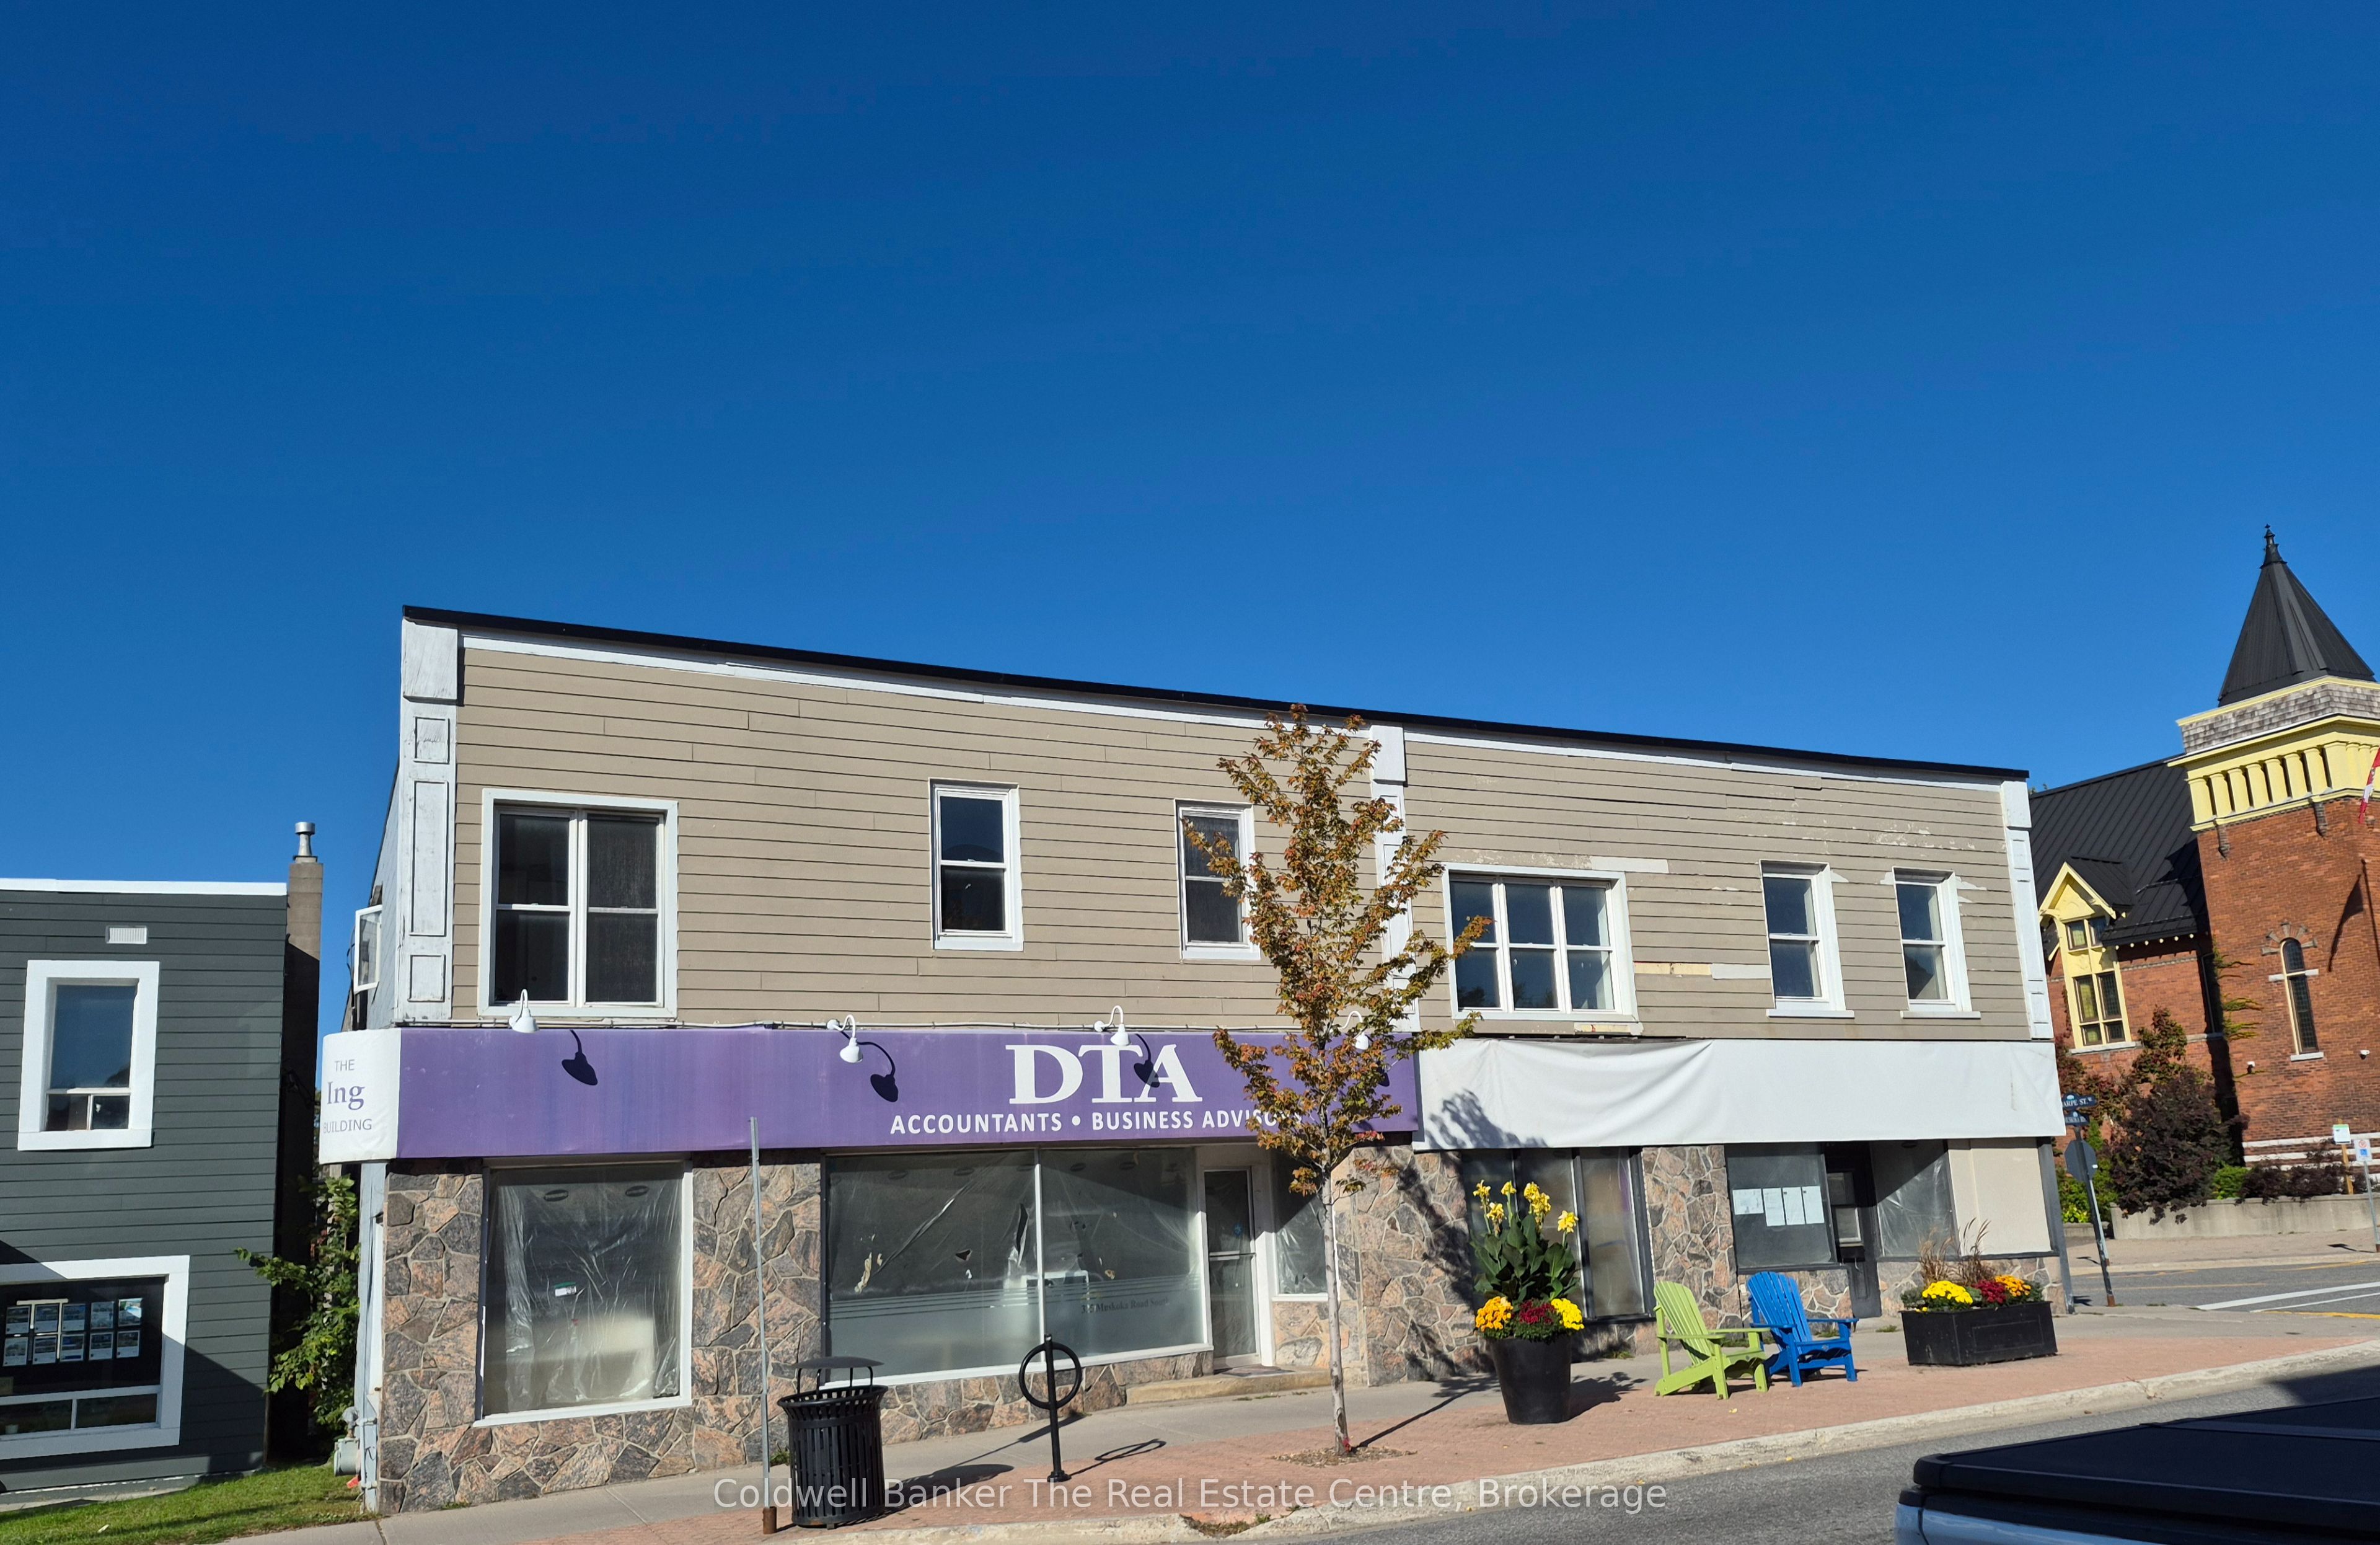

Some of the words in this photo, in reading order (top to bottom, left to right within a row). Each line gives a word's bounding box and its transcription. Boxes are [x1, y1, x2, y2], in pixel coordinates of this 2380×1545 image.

[335, 1059, 355, 1071] THE
[1005, 1044, 1203, 1104] DTA
[327, 1081, 366, 1110] Ing
[323, 1118, 372, 1133] BUILDING
[890, 1113, 1062, 1135] ACCOUNTANTS
[1091, 1110, 1194, 1130] BUSINESS
[1202, 1108, 1302, 1128] ADVISO
